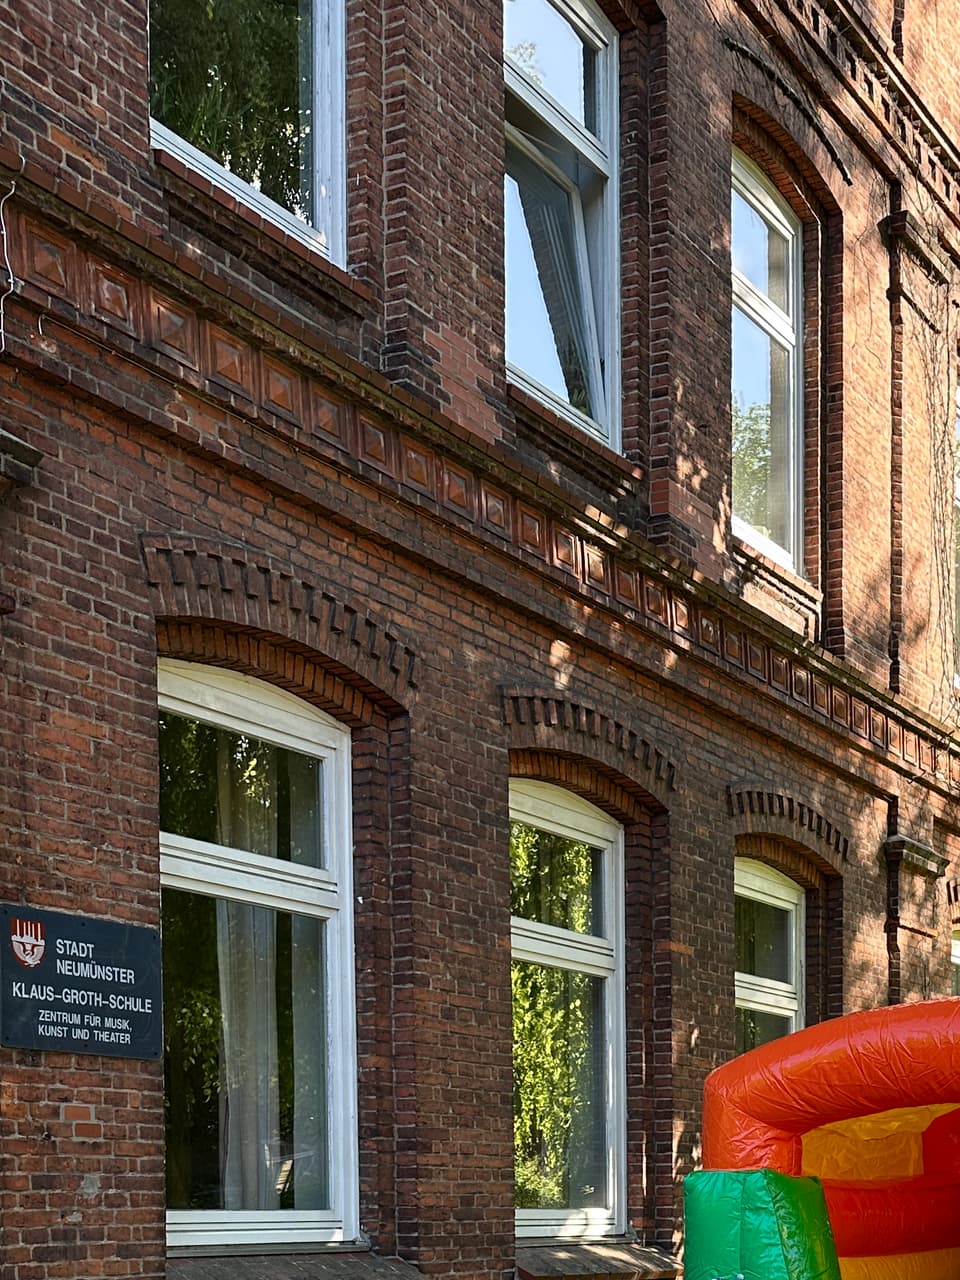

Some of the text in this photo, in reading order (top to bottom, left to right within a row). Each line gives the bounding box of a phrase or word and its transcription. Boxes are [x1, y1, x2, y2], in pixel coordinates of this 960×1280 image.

[56, 939, 94, 958] STADT
[57, 959, 135, 984] NEUMÜNSTER
[12, 982, 152, 1012] KLAUS-GROTH-SCHULE
[39, 1010, 132, 1032] ZENTRUM FÜR MUSIK,
[38, 1025, 131, 1044] KUNST UND THEATER
